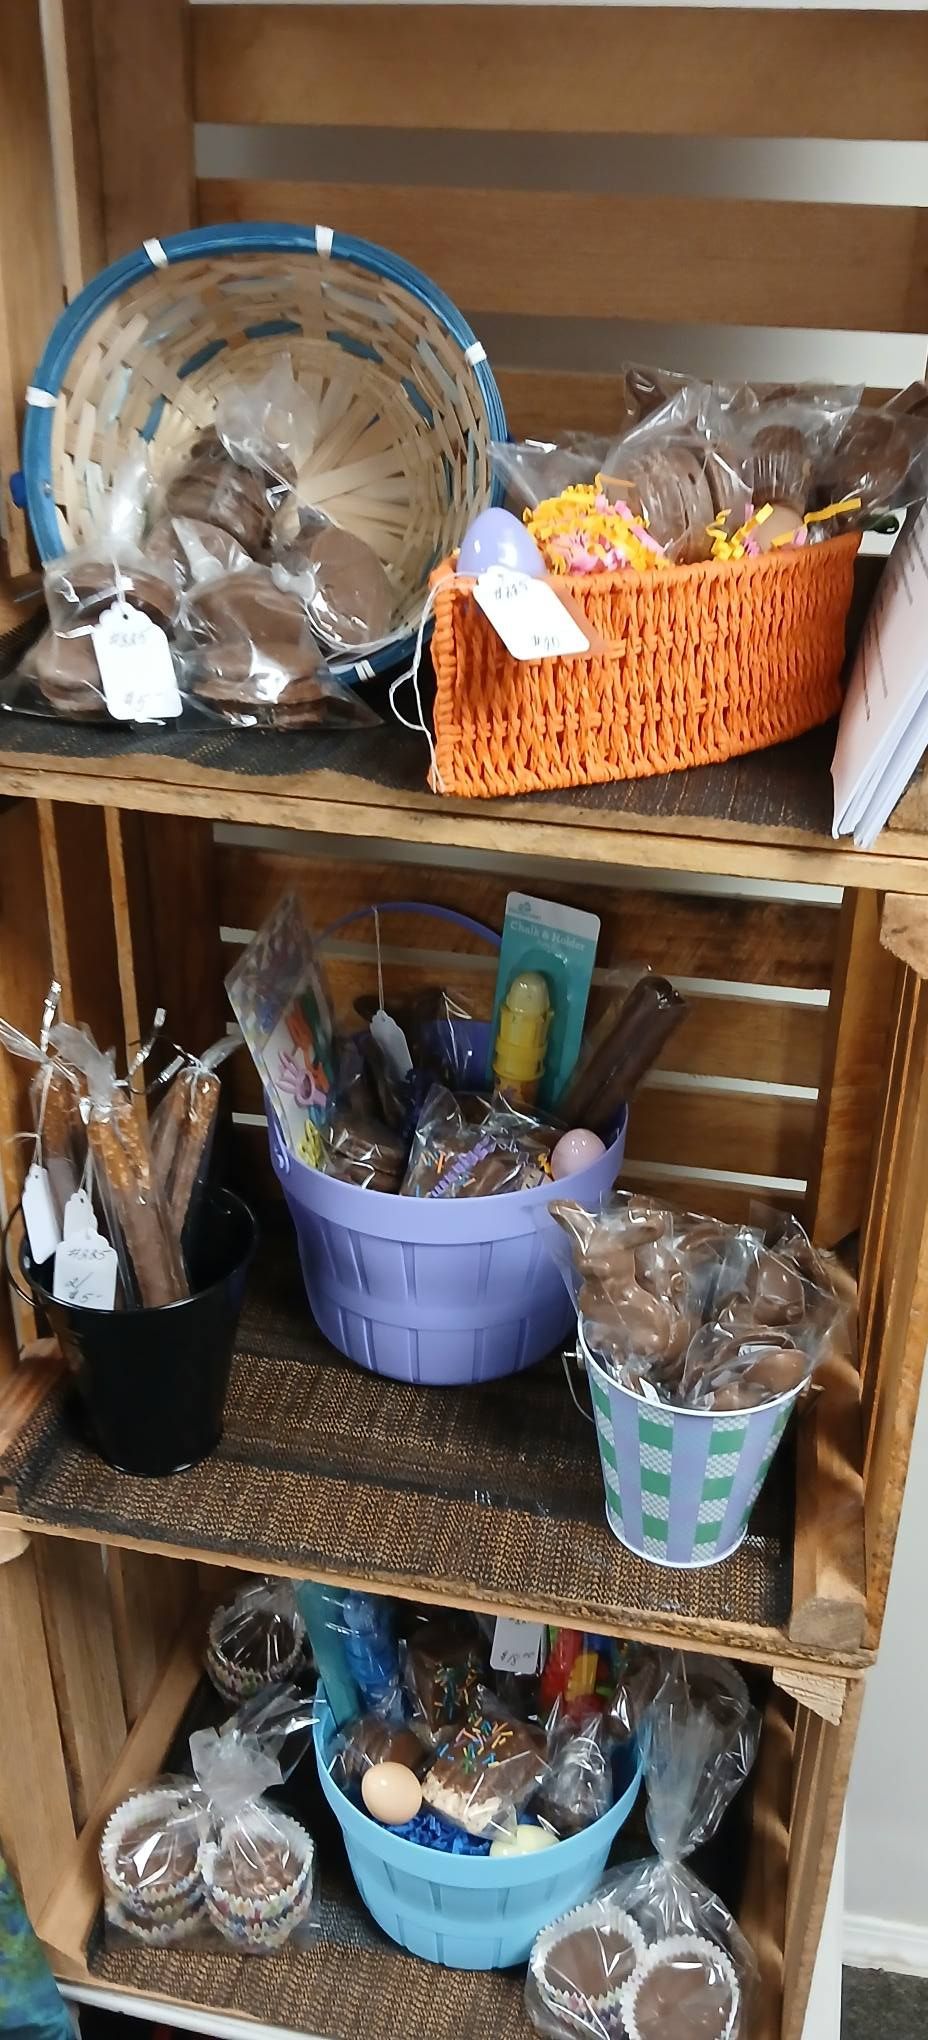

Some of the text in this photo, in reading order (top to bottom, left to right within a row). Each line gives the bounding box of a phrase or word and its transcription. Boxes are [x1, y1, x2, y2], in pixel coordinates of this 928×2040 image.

[510, 920, 540, 937] Chalk
[542, 931, 550, 940] &
[551, 931, 585, 953] Holder
